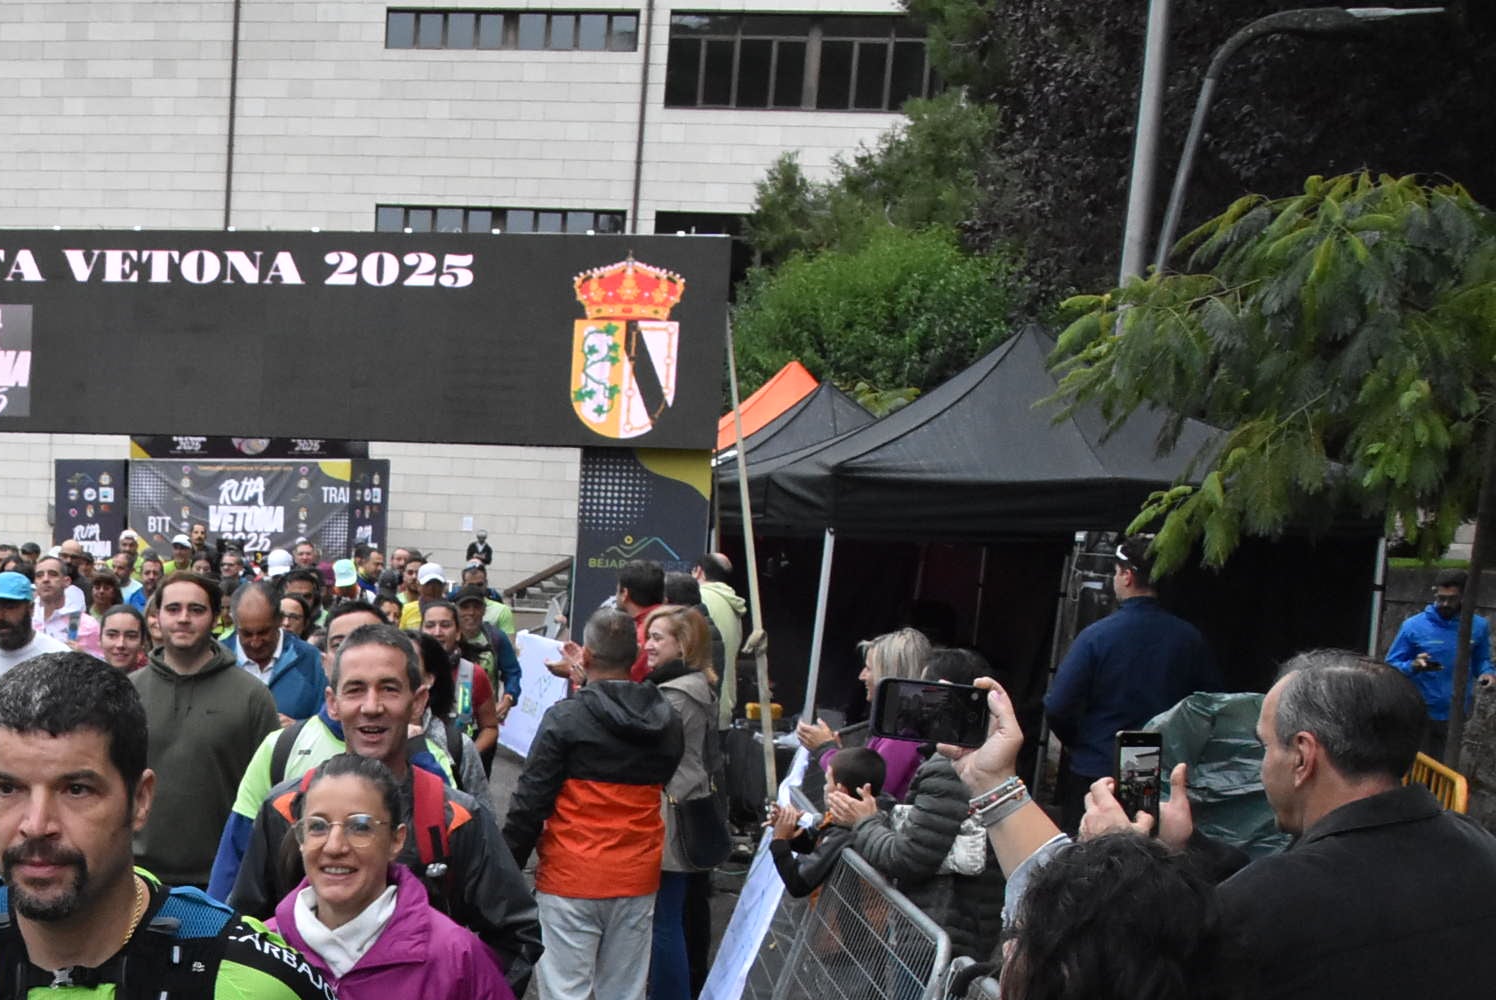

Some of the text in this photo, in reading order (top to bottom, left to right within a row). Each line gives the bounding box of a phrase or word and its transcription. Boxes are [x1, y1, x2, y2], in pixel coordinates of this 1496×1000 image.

[62, 249, 305, 285] VETONA
[323, 251, 475, 288] 2025
[218, 475, 265, 507] RUTA
[321, 486, 350, 503] TRAI
[147, 515, 171, 533] BTT
[208, 505, 284, 533] VETONA
